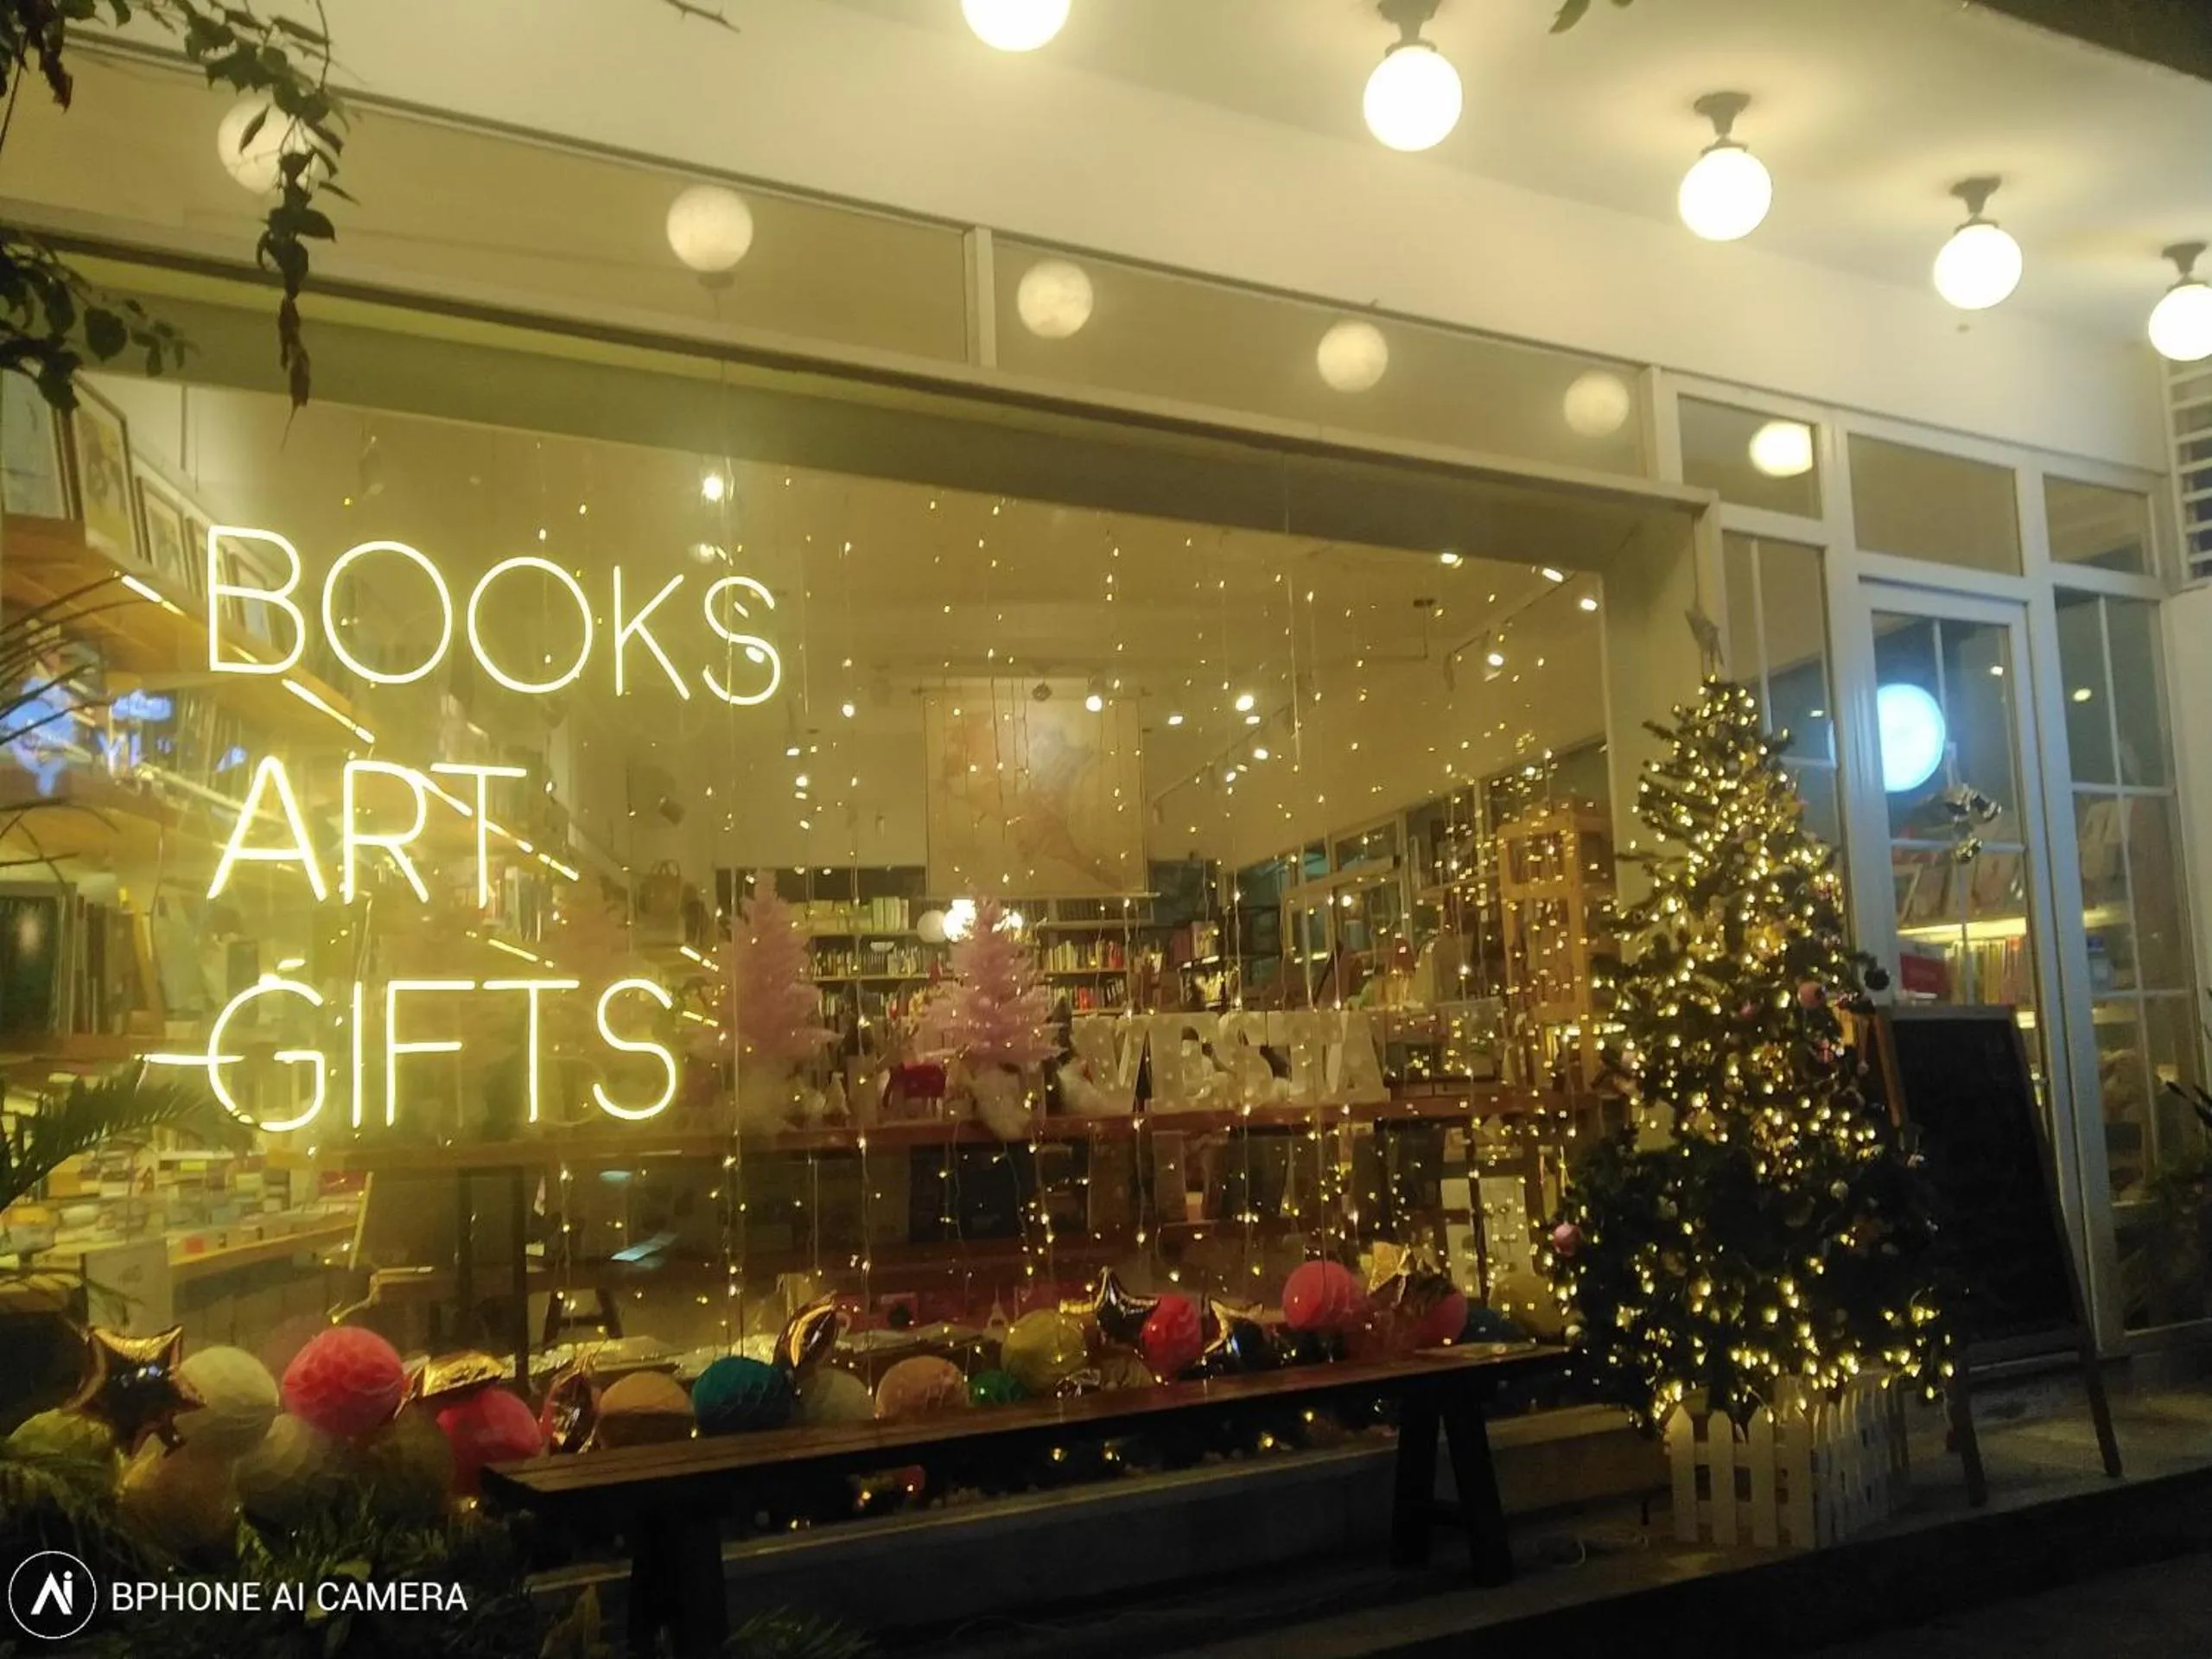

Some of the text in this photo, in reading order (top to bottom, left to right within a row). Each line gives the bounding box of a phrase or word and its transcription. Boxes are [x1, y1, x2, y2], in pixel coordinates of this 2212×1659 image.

[207, 524, 782, 705] BOOKS
[207, 755, 528, 909] ART
[207, 978, 678, 1132] GIFTS
